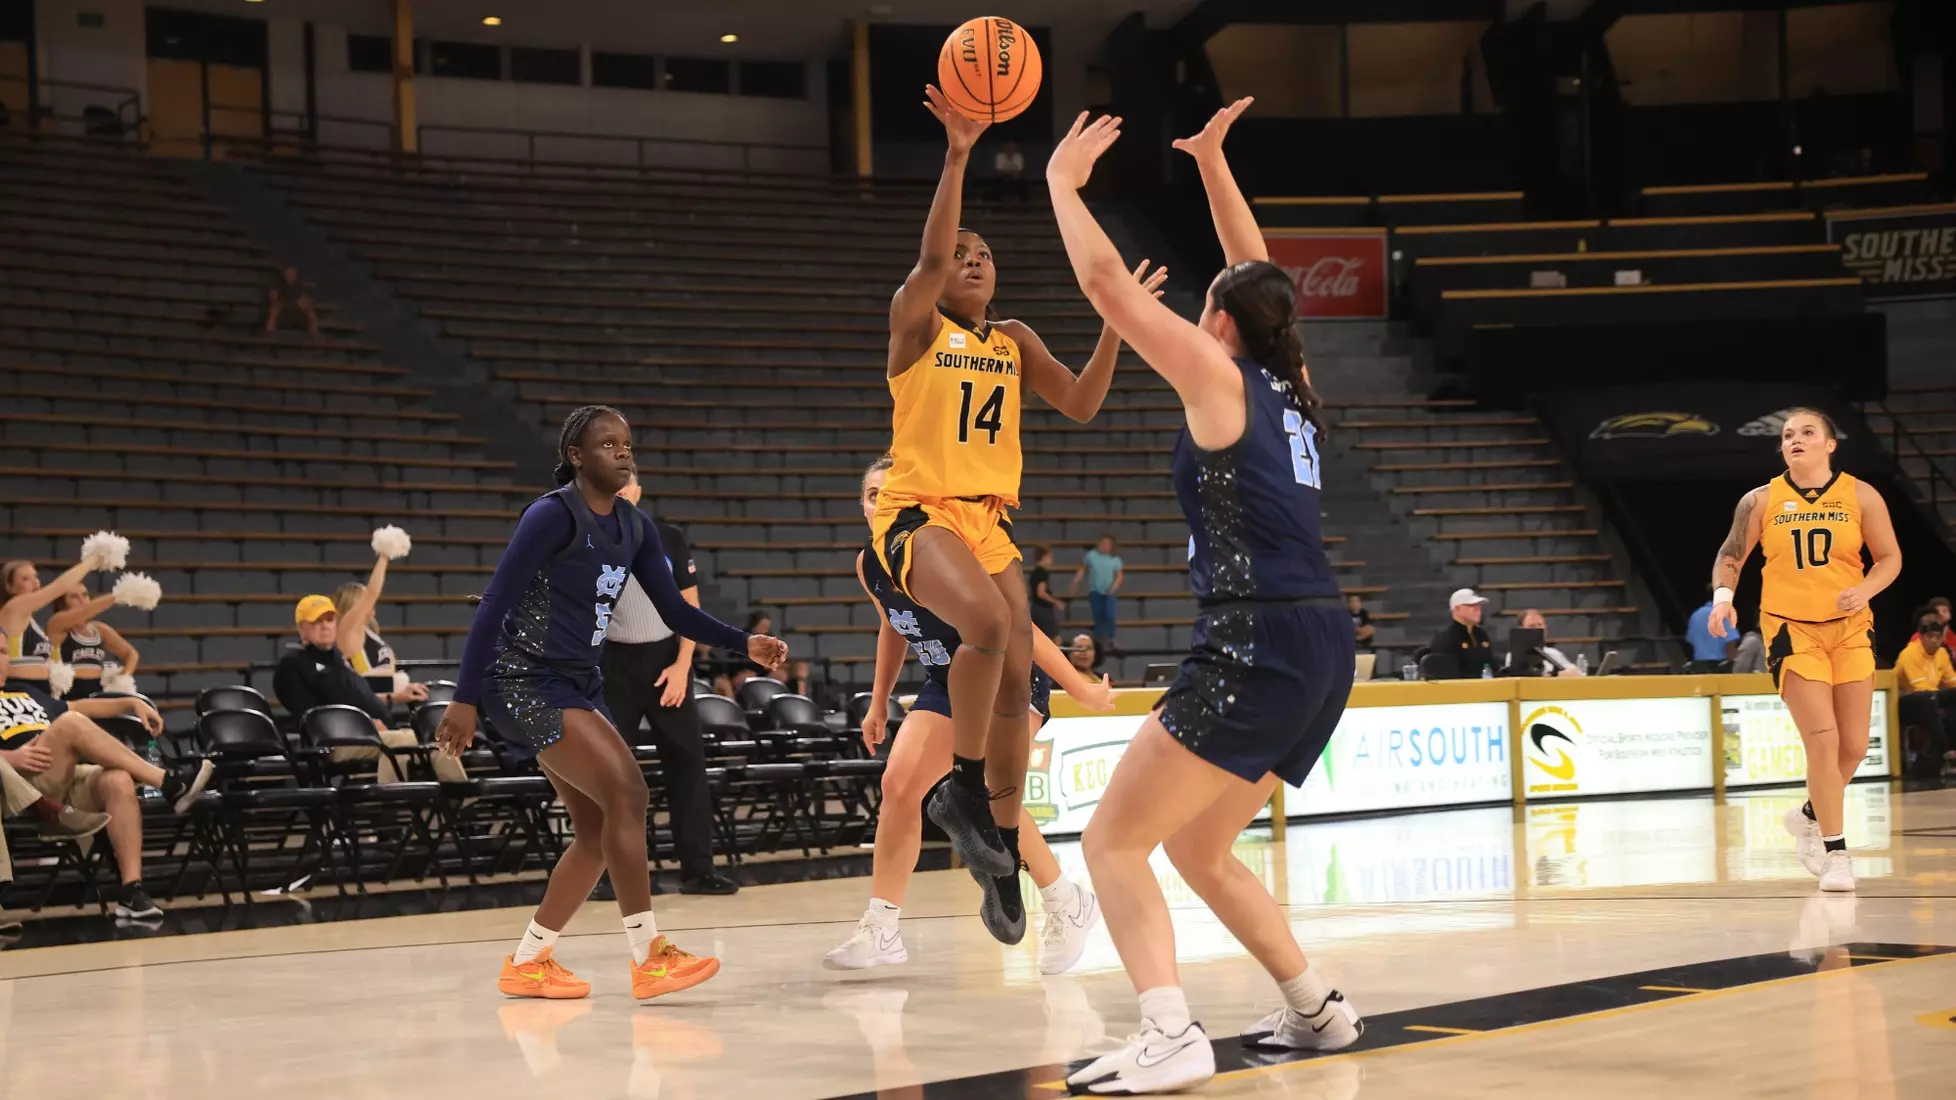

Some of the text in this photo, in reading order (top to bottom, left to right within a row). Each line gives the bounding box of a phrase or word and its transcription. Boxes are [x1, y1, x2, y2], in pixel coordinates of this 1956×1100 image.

[993, 19, 1017, 76] Wilson
[1882, 256, 1945, 284] MISS
[935, 351, 1004, 374] SOUTHERN
[958, 380, 1006, 445] 14
[1773, 511, 1849, 526] SOUTHERN MISS
[1790, 527, 1833, 570] 10
[1073, 758, 1108, 792] KEG
